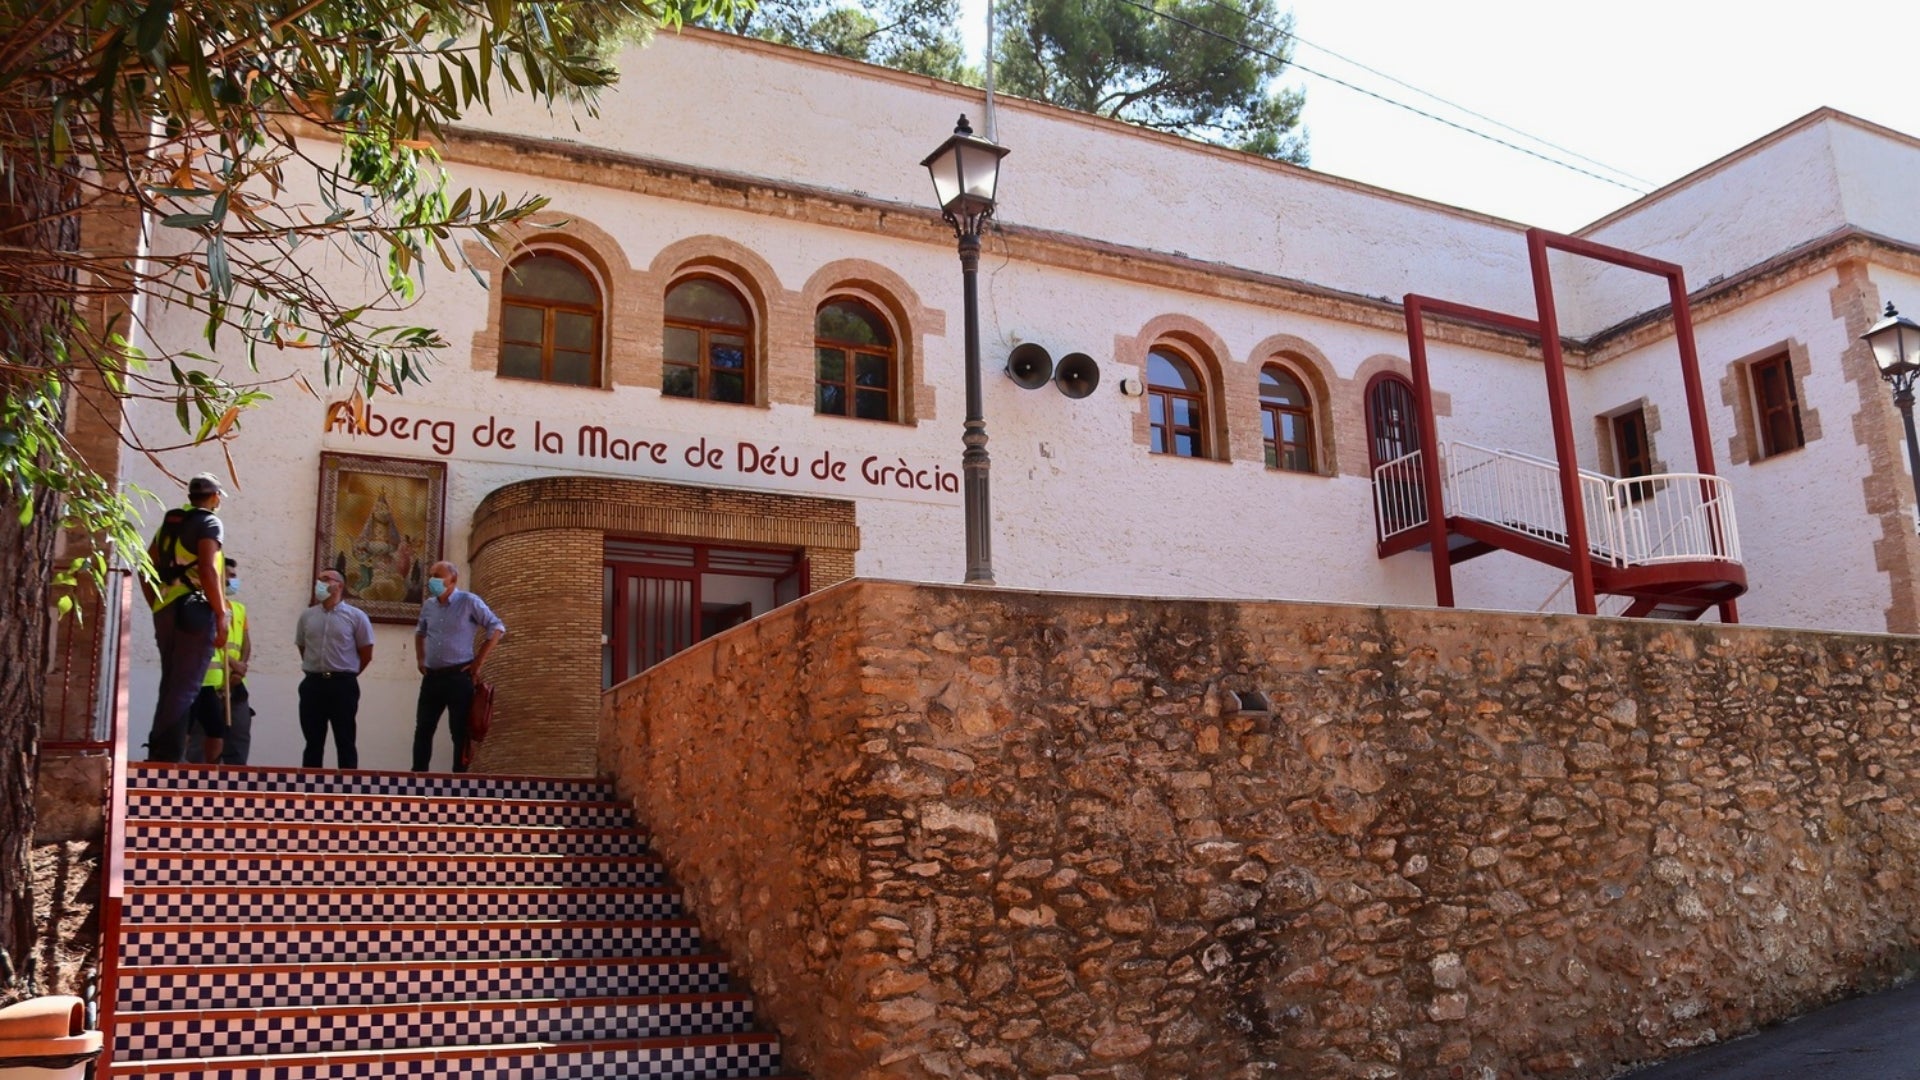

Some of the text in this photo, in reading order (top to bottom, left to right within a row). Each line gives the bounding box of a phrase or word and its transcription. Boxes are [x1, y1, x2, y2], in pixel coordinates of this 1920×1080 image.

[325, 401, 960, 493] Aberg de la Mare de Déu de Gràcia
